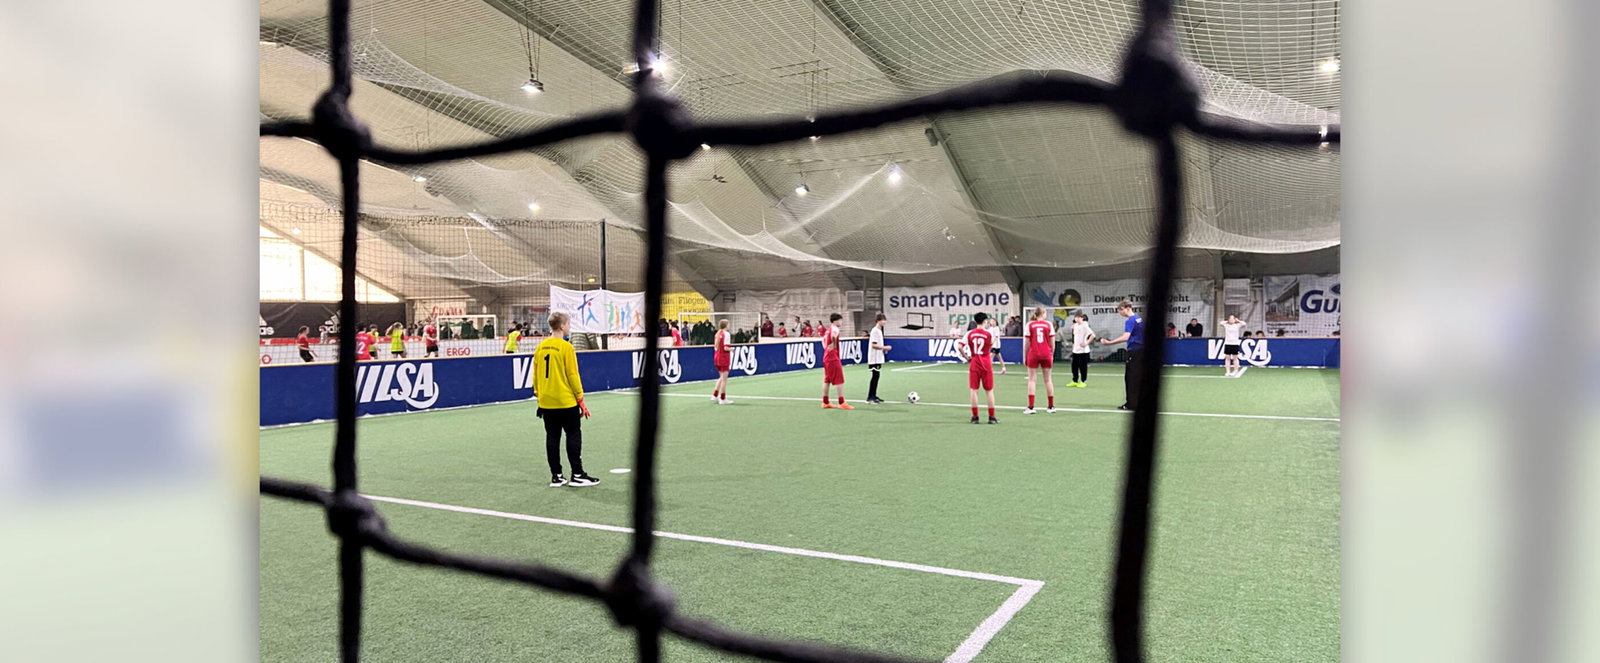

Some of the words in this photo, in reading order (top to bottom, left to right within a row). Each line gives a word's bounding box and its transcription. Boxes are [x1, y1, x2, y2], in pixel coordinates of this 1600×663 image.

[889, 290, 1010, 311] smartphone
[1300, 289, 1340, 313] Gu
[972, 337, 985, 355] 12
[1036, 327, 1044, 344] 5
[446, 347, 470, 356] ERGO
[786, 342, 817, 370] VILSA
[543, 353, 550, 379] 1
